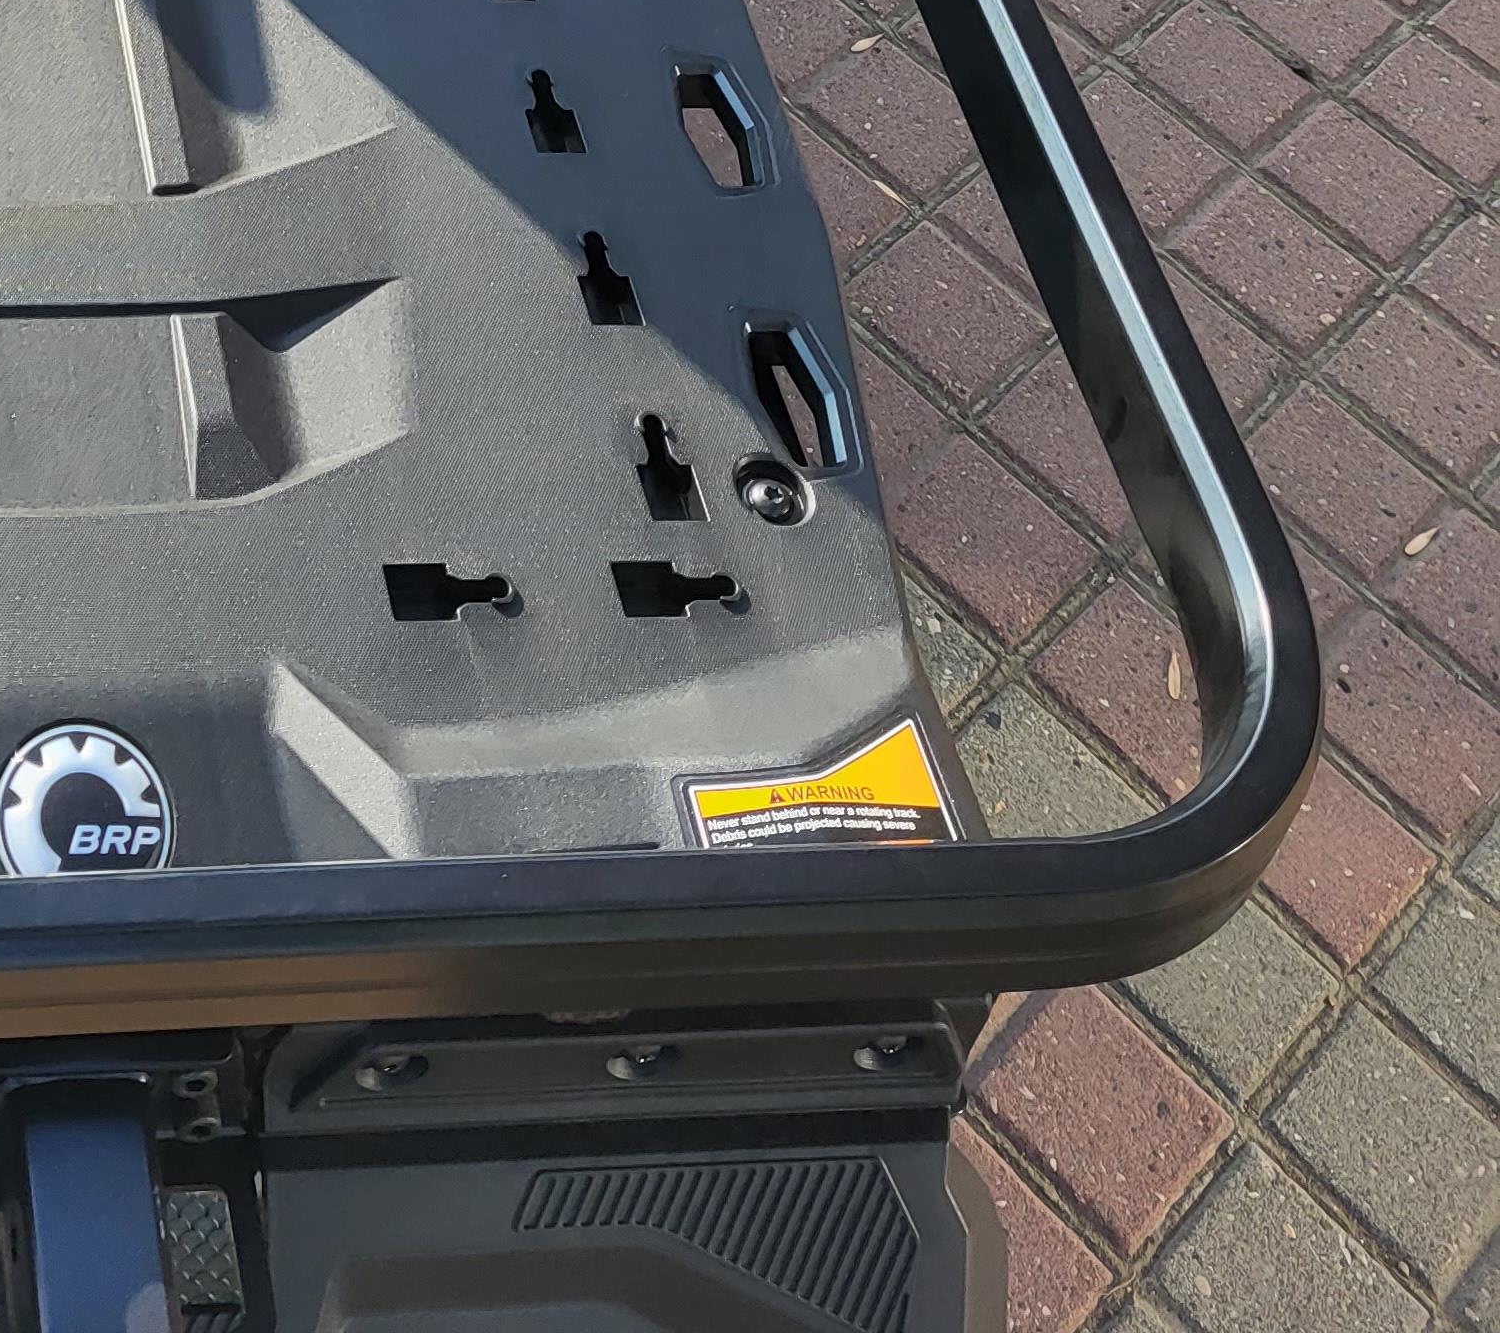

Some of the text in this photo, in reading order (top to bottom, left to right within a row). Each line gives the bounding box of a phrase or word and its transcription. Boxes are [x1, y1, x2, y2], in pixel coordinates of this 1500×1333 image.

[786, 785, 875, 801] WARNING
[707, 806, 921, 831] Never stand behind or near a rotating track.
[711, 829, 747, 845] Debris
[748, 823, 777, 838] could
[777, 823, 793, 834] be
[793, 817, 842, 833] projected
[843, 818, 882, 831] causing
[882, 821, 916, 831] severe
[68, 824, 161, 856] BRP
